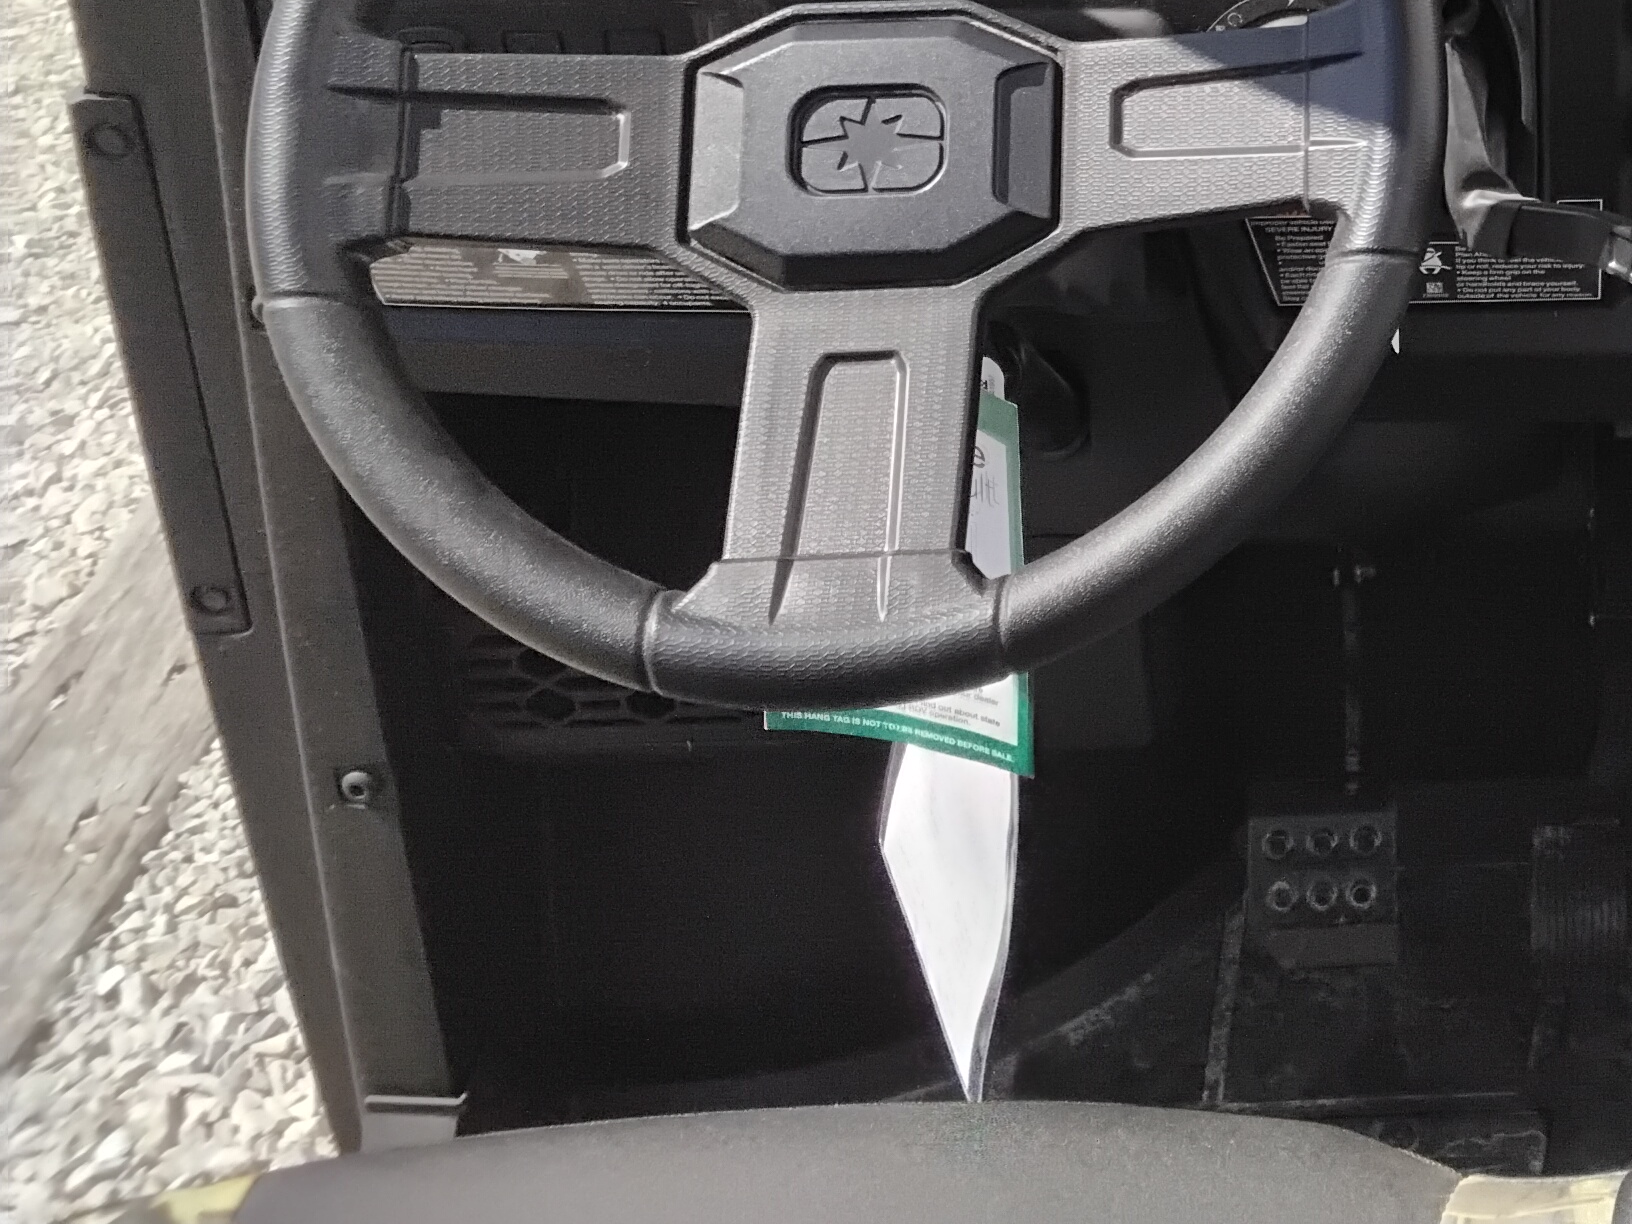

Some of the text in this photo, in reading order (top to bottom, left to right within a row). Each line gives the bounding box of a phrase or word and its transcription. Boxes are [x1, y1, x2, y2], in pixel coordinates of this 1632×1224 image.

[954, 708, 979, 720] about
[781, 711, 803, 720] THIS
[804, 712, 831, 722] HANG
[832, 715, 851, 724] TAG
[852, 717, 861, 725] IS
[863, 718, 882, 728] NOT
[915, 728, 956, 745] REMOVED
[957, 739, 990, 755] BEFORE
